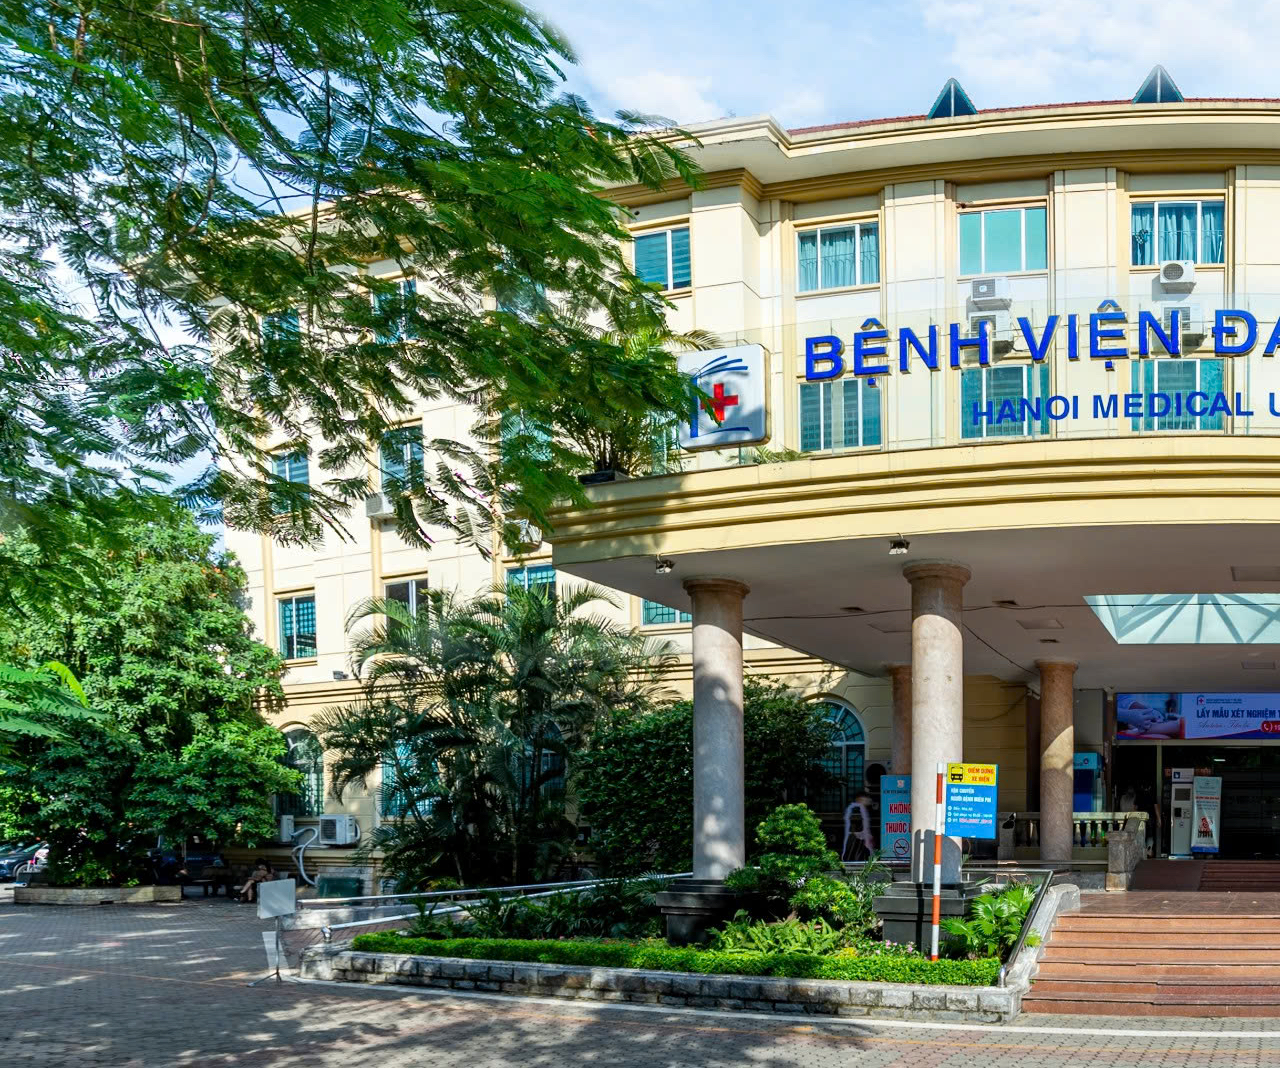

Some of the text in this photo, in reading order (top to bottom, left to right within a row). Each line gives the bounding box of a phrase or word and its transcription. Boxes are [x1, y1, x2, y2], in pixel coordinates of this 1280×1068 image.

[806, 317, 993, 388] BỆNH
[1018, 299, 1183, 370] VIỆN
[972, 395, 1079, 426] HANOI
[1093, 392, 1254, 419] MEDICAL
[1196, 706, 1210, 718] LẤY
[1231, 707, 1245, 717] XÉT
[1247, 707, 1276, 719] NGHIỆM
